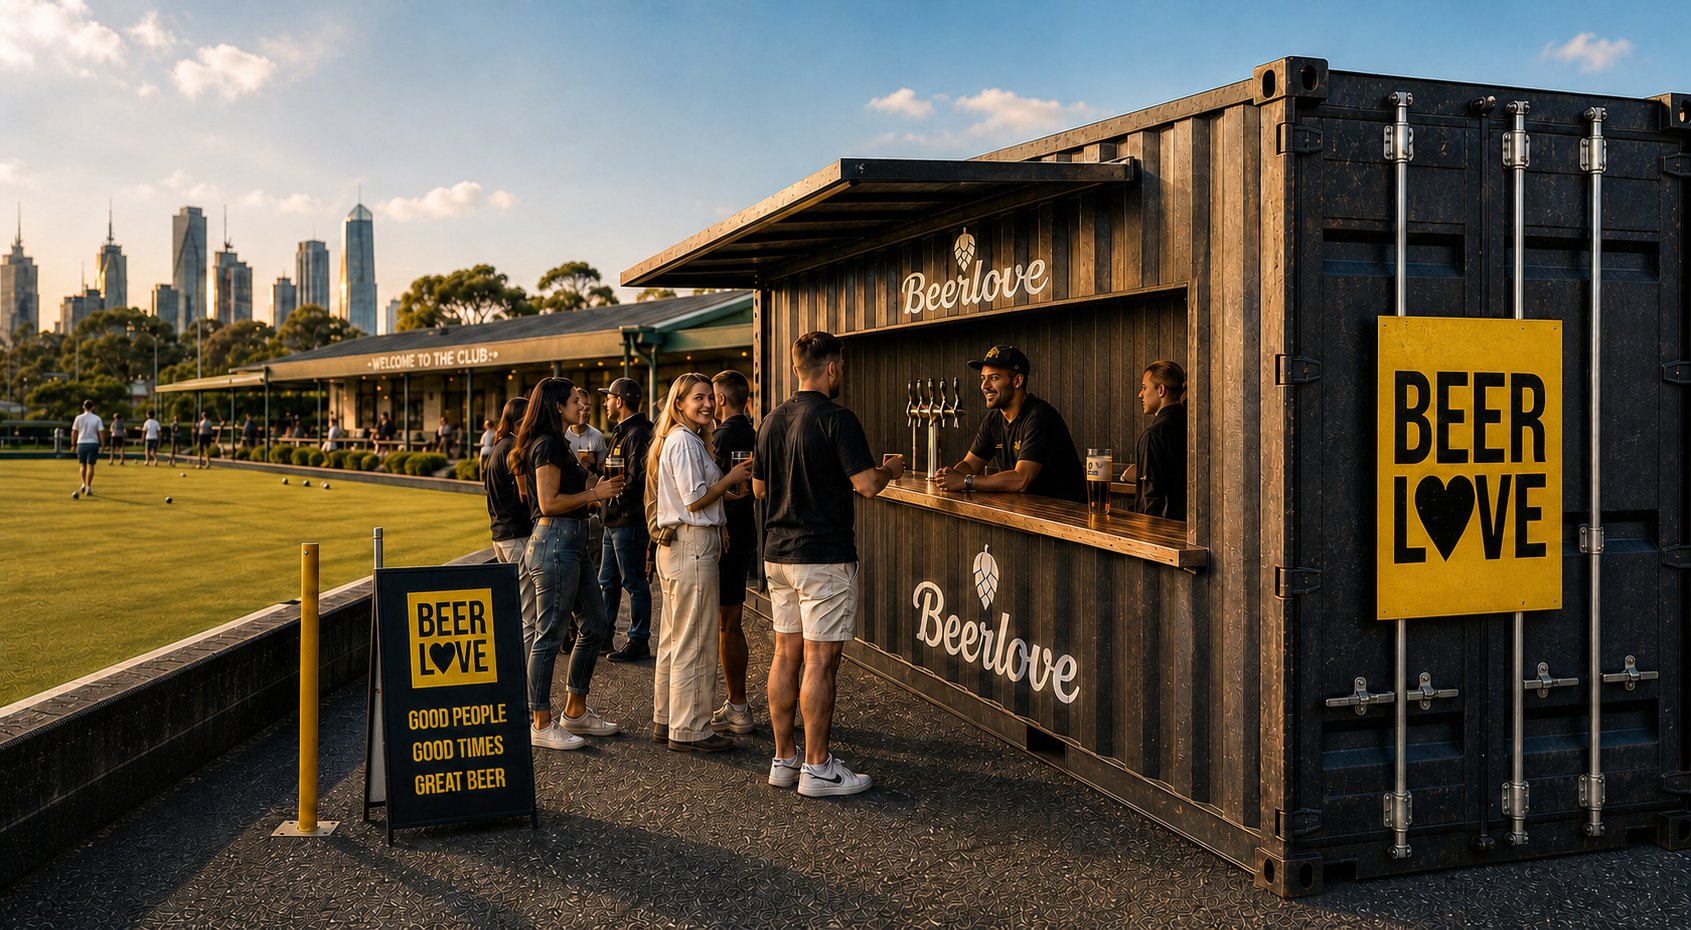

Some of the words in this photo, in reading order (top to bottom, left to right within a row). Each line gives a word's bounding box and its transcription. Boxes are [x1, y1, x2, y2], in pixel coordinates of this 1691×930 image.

[901, 259, 1049, 315] Beerlove
[371, 354, 415, 371] WELCOME
[417, 352, 431, 367] TO
[433, 350, 454, 366] THE
[1394, 370, 1546, 464] BEER
[417, 600, 487, 638] BEER
[912, 580, 1080, 704] Beerlove
[408, 707, 450, 731] GOOD
[452, 703, 508, 727] PEOPLE
[412, 739, 454, 763] GOOD
[457, 735, 504, 758] TIMES
[414, 771, 463, 796] GREAT
[466, 767, 506, 790] BEER
